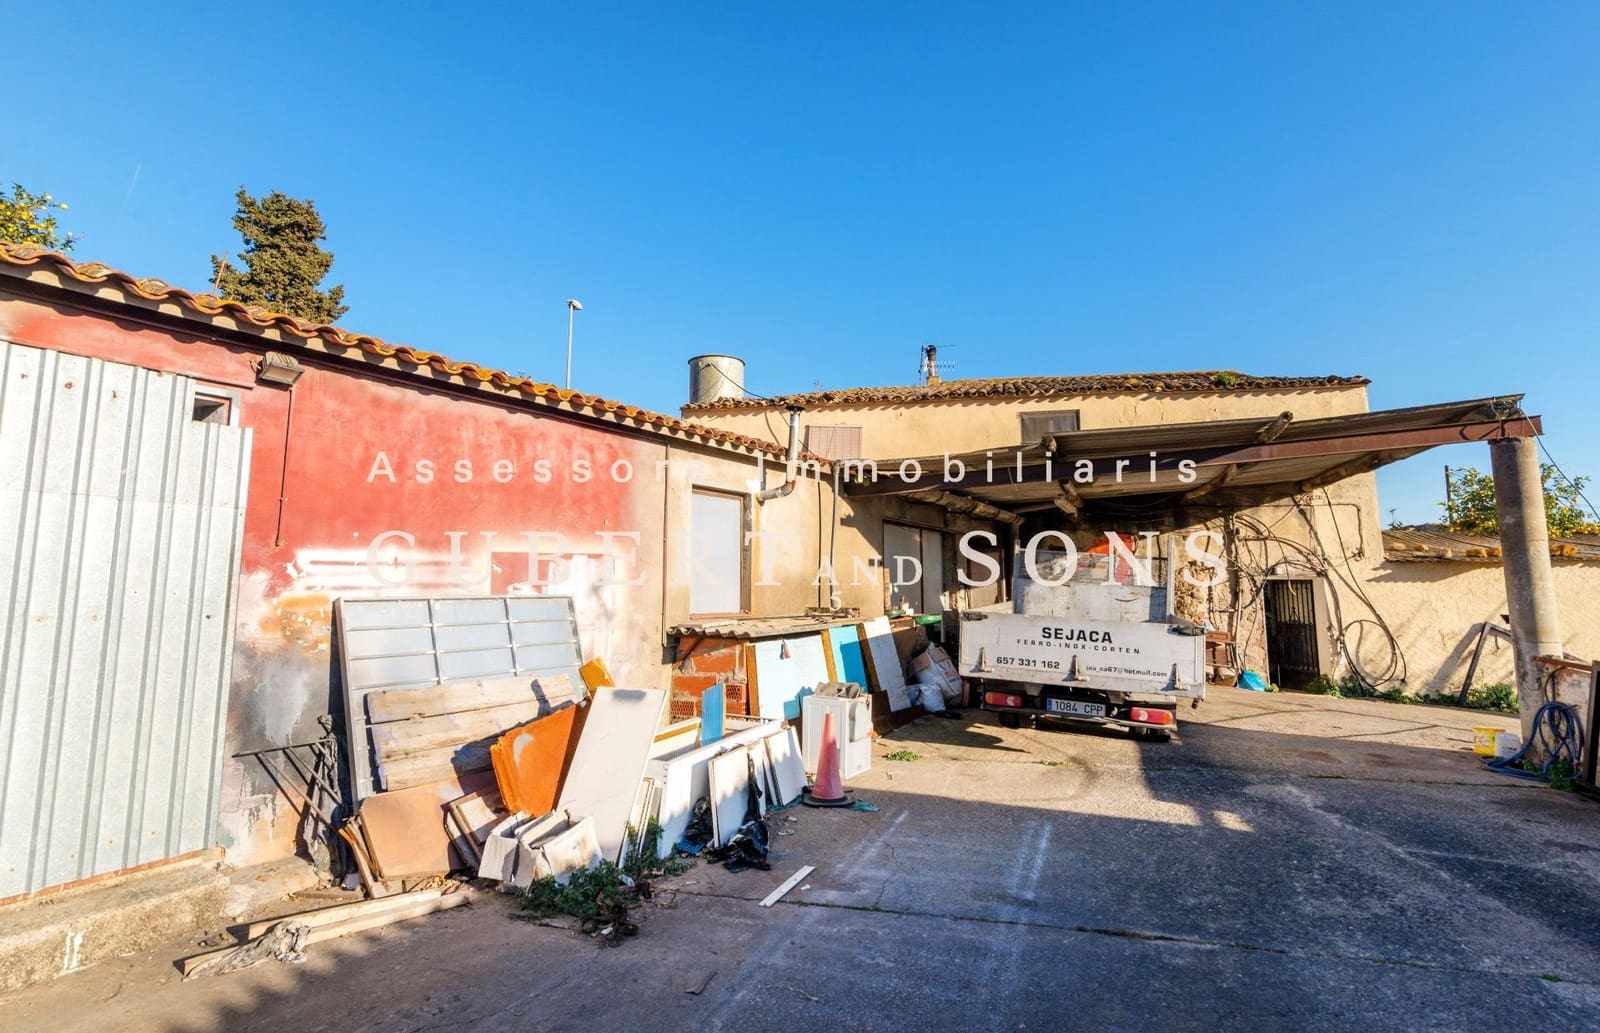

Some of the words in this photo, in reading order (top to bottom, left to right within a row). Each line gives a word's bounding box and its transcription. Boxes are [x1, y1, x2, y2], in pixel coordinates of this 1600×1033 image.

[1041, 626, 1113, 644] SEJACA
[996, 656, 1015, 665] 657
[1018, 658, 1037, 667] 331
[1041, 660, 1060, 670] 162
[1055, 701, 1078, 713] 1084
[1083, 704, 1103, 715] CPP
